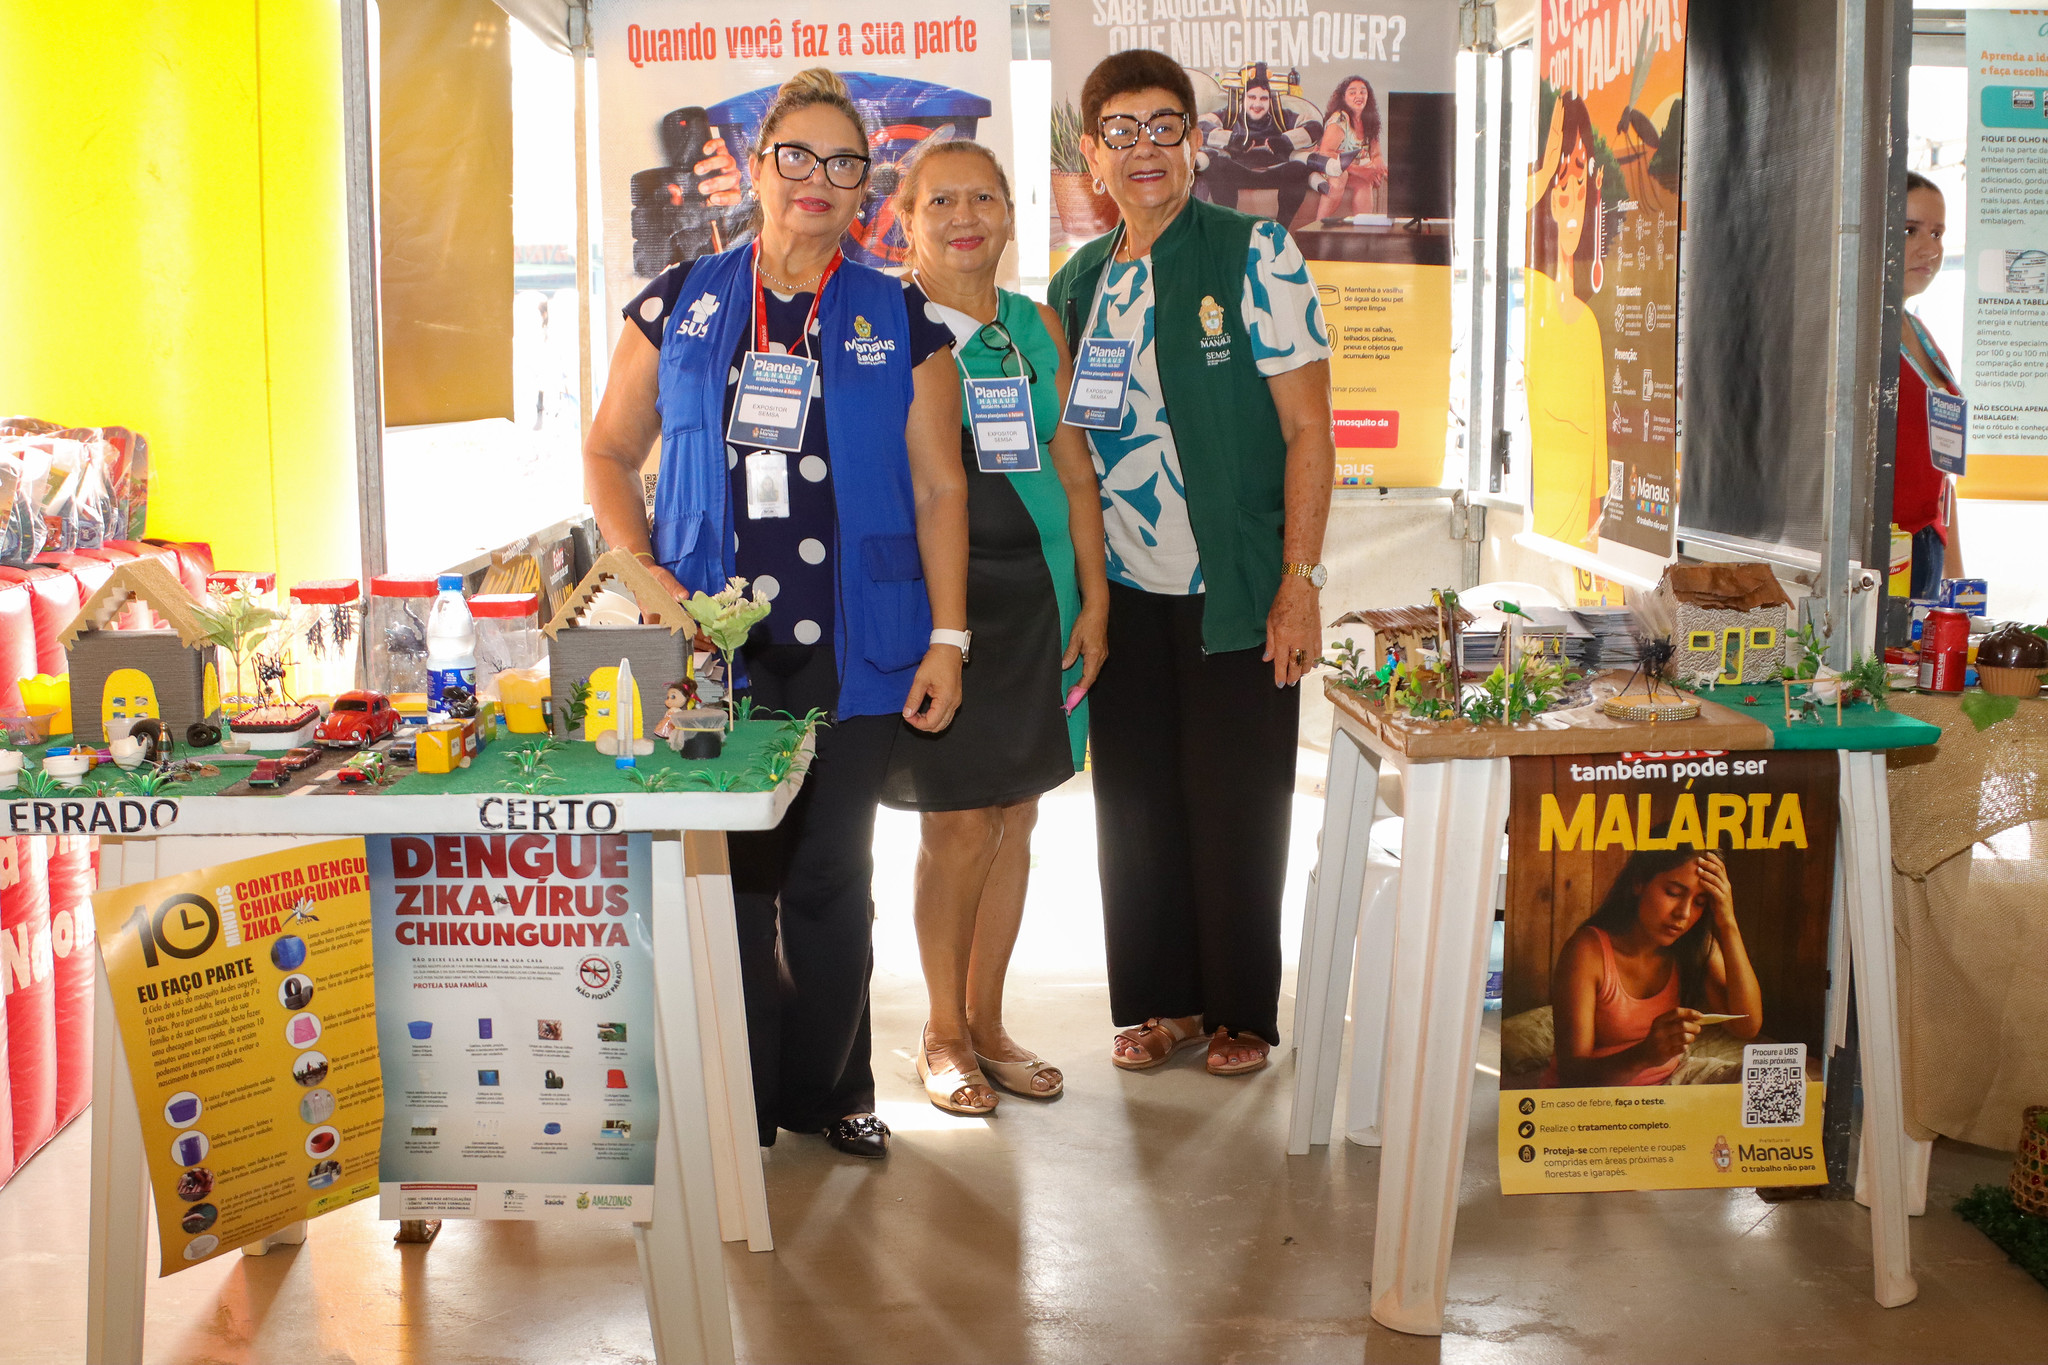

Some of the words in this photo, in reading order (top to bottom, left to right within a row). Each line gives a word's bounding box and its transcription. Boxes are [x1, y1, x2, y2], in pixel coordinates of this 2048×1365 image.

[627, 22, 717, 67] Quando
[726, 18, 783, 59] você
[792, 19, 829, 57] faz
[838, 26, 853, 55] a
[861, 21, 905, 55] sua
[915, 15, 977, 58] parte
[1312, 11, 1407, 62] QUER?
[1981, 51, 2025, 62] Aprenda
[1989, 66, 2010, 76] faça
[676, 319, 709, 338] SUS
[844, 338, 895, 353] Manaus
[1089, 346, 1125, 357] Planeja
[1206, 349, 1231, 360] SEMSA
[754, 360, 803, 375] Planeja
[756, 371, 798, 380] MANAUS
[975, 386, 1018, 398] Planeja
[753, 404, 787, 413] EXPOSITOR
[1337, 418, 1376, 428] mosquito
[1378, 419, 1388, 427] da
[1637, 476, 1670, 503] Manaus
[1936, 653, 1944, 690] RECICLE-ME
[1570, 758, 1667, 781] também
[1672, 758, 1729, 783] pode
[1733, 758, 1767, 776] ser
[9, 799, 179, 834] ERRADO
[479, 797, 618, 832] CERTO
[1539, 778, 1808, 851] MALÁRIA
[390, 833, 629, 879] DENGUE
[235, 868, 305, 901] CONTRA
[239, 876, 361, 922] CHIKUNGUNYA
[395, 885, 495, 916] ZIKA
[504, 877, 629, 917] VÍRUS
[215, 884, 242, 948] MINUTOS
[120, 892, 220, 969] 10
[243, 915, 282, 942] ZIKA
[395, 921, 630, 947] CHIKUNGUNYA
[137, 983, 159, 1004] EU
[161, 971, 202, 999] FAÇO
[205, 957, 254, 985] PARTE
[1752, 1049, 1778, 1057] Procure
[1784, 1047, 1798, 1055] UBS
[1769, 1057, 1798, 1066] próxima.
[1541, 1100, 1554, 1109] Em
[1557, 1100, 1575, 1108] caso
[1577, 1099, 1588, 1107] de
[1590, 1098, 1613, 1107] febre,
[1615, 1098, 1633, 1108] faça
[1540, 1125, 1568, 1133] Realize
[1578, 1123, 1627, 1131] tratamento
[1629, 1122, 1671, 1132] completo.
[1544, 1146, 1588, 1156] Proteja-se
[1589, 1146, 1607, 1154] com
[1609, 1145, 1648, 1154] repelente
[1658, 1143, 1686, 1153] roupas
[1738, 1144, 1813, 1162] Manaus
[1544, 1157, 1587, 1168] compridas
[1605, 1156, 1627, 1165] áreas
[1629, 1155, 1667, 1165] próximas
[1749, 1165, 1782, 1173] trabalho
[1783, 1164, 1797, 1172] não
[1545, 1170, 1581, 1179] florestas
[1591, 1168, 1627, 1179] igarapés.
[545, 1198, 565, 1206] Saúde
[592, 1195, 632, 1207] AMAZONAS
